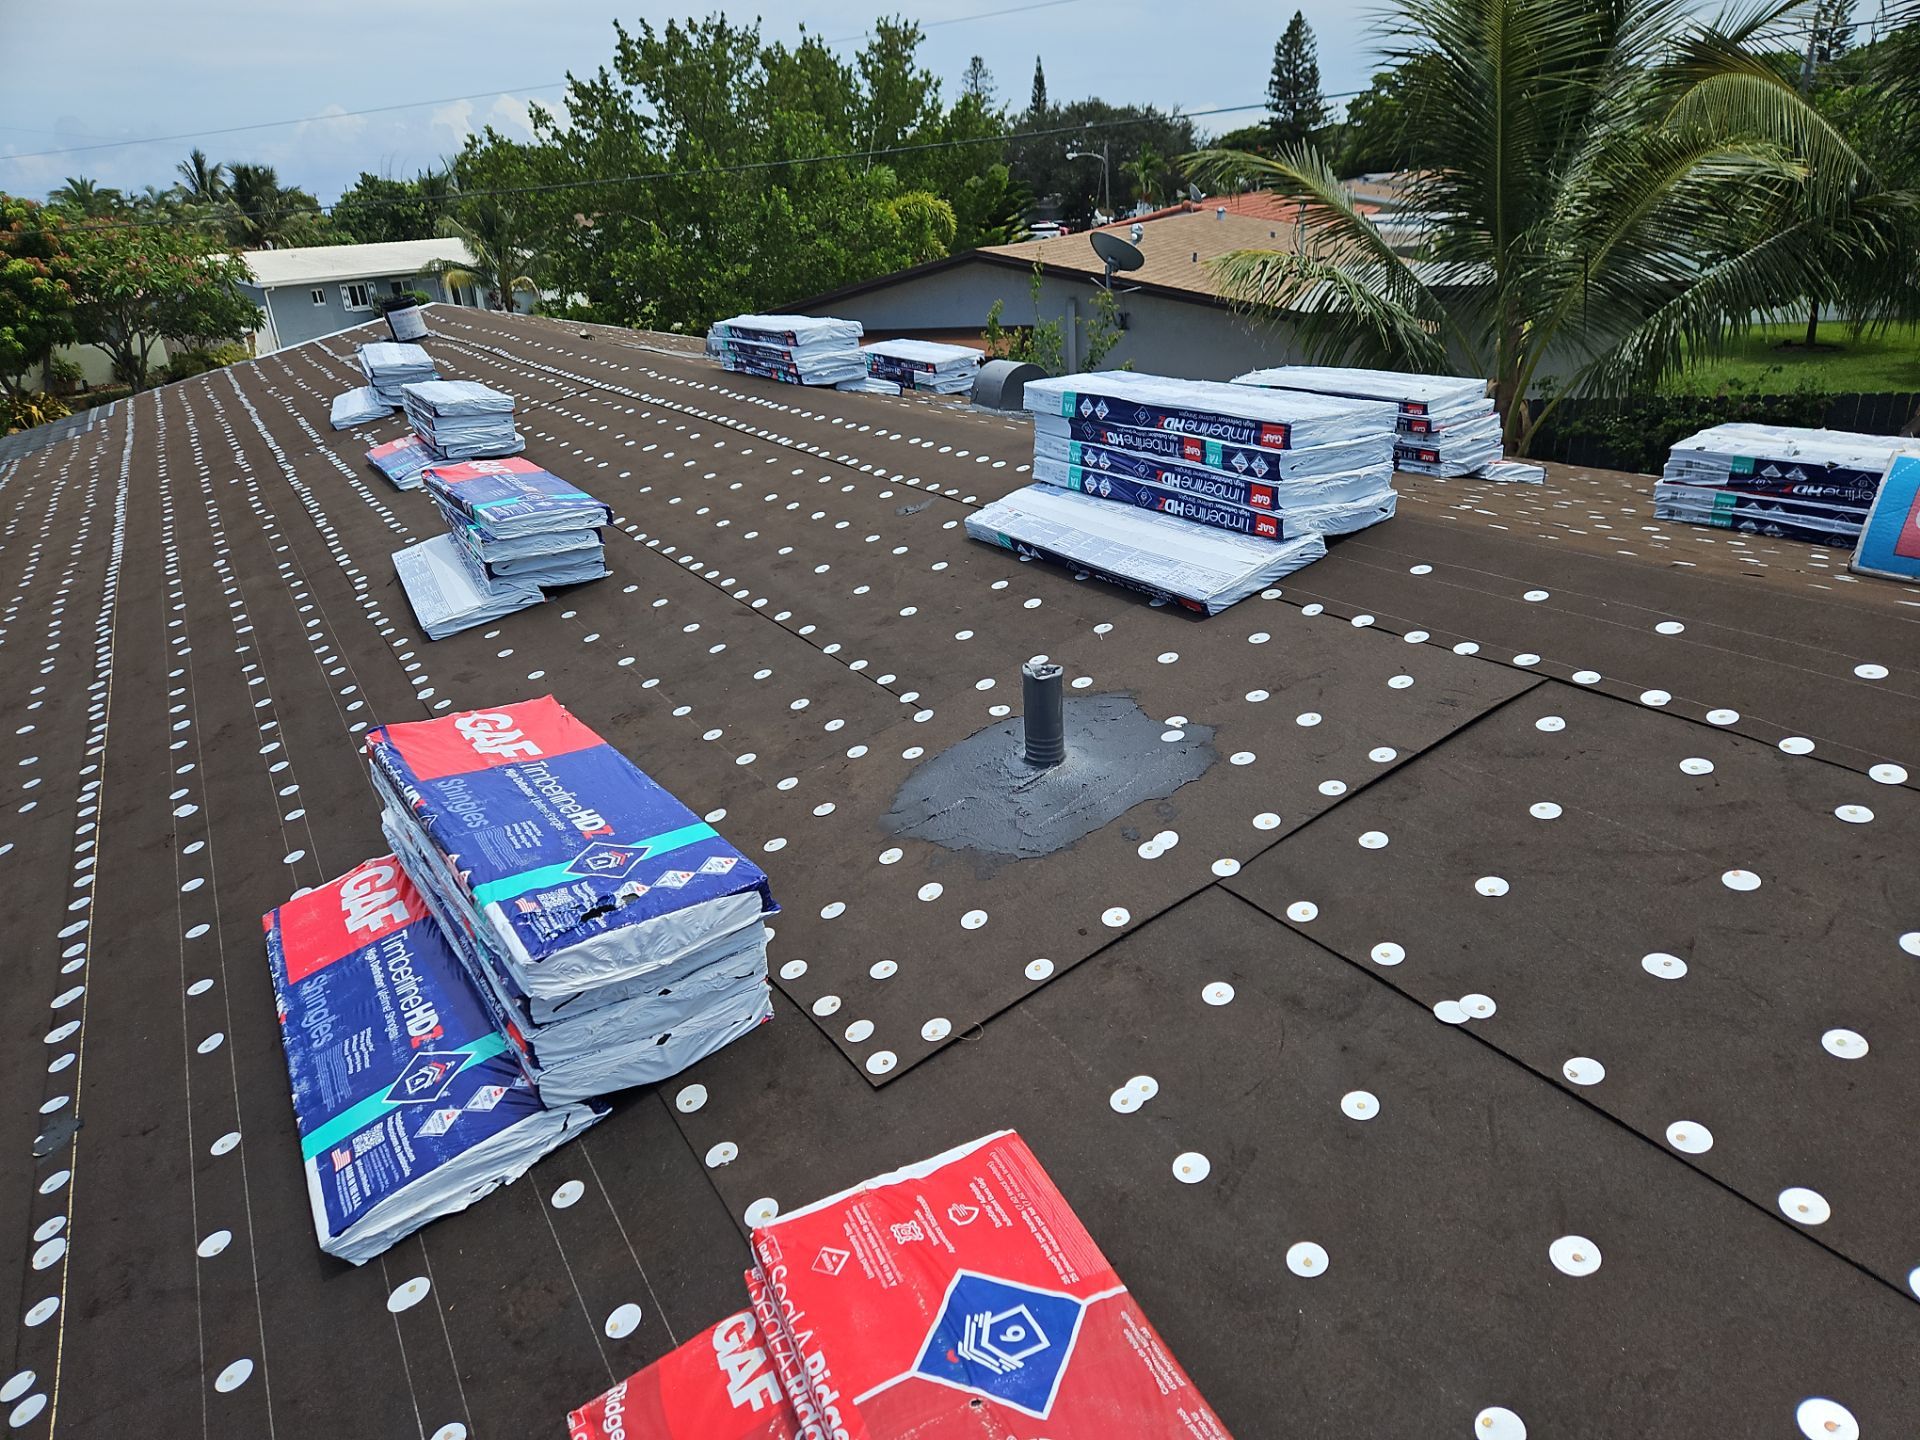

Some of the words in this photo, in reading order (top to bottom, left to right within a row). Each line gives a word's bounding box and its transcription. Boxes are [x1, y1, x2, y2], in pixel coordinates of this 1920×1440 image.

[1262, 433, 1282, 444] GAF
[1252, 494, 1270, 504] GAF
[1258, 522, 1276, 534] GAF
[455, 713, 544, 758] GAF
[438, 779, 488, 828] Shingles
[340, 866, 410, 934] GAF
[301, 974, 336, 1048] Shingles
[712, 1312, 783, 1412] GAF
